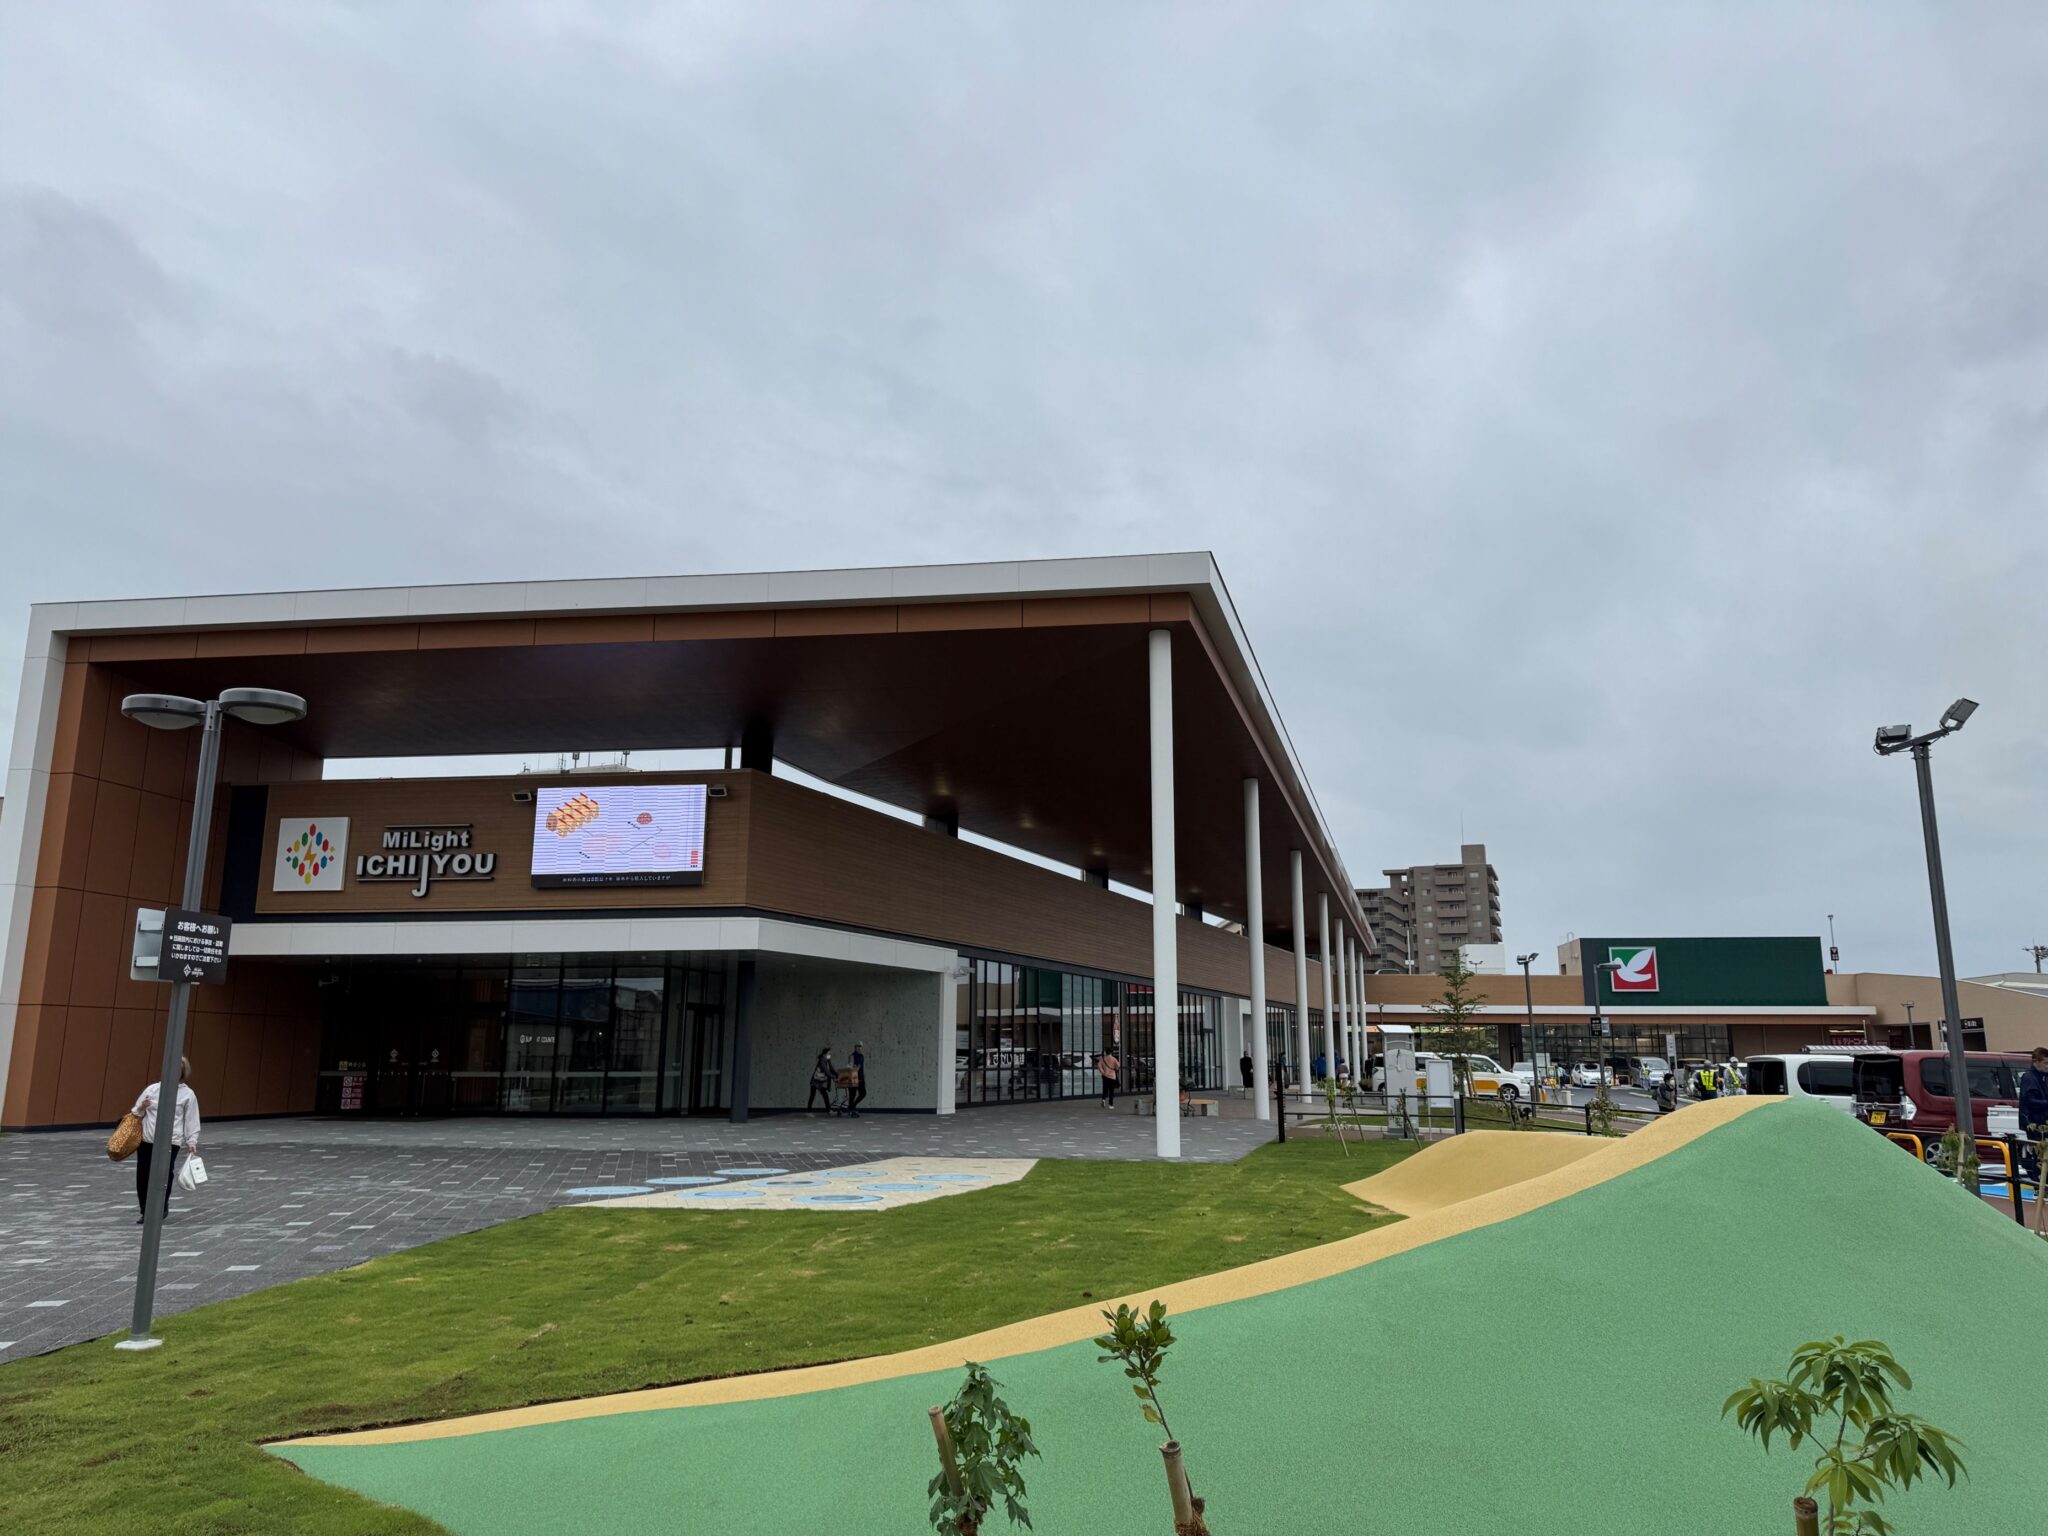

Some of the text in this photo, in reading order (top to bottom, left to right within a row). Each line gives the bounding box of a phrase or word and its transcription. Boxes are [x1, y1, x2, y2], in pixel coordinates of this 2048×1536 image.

[382, 830, 470, 852] MiLight
[355, 853, 495, 897] ICHIJYOU
[177, 921, 219, 934] お客様へお願い
